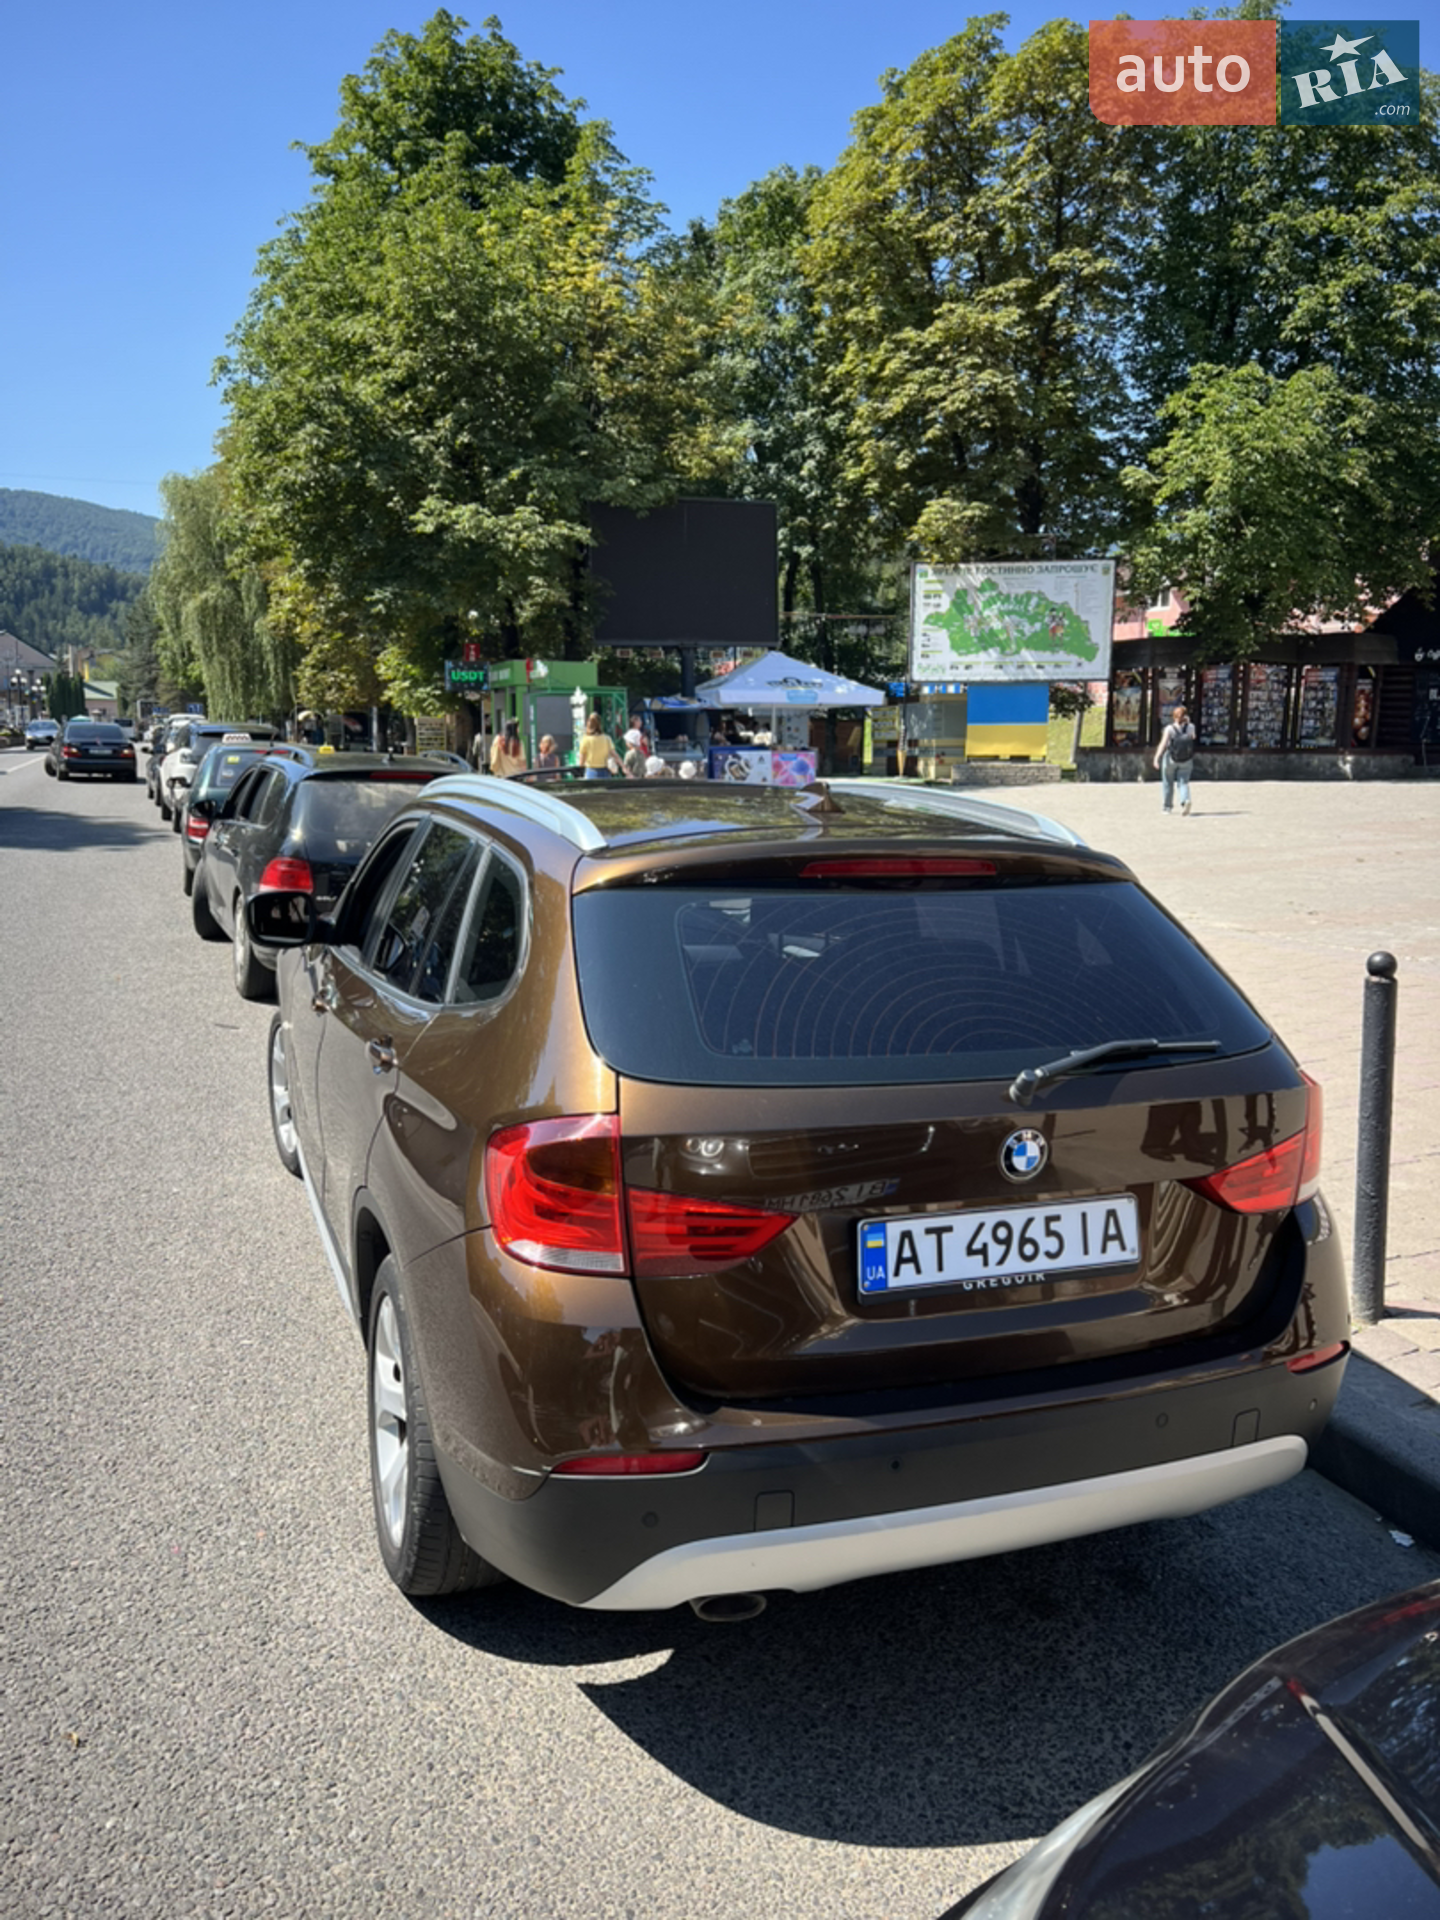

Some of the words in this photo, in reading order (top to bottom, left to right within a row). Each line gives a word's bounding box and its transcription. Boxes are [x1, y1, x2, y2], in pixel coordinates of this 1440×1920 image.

[976, 564, 1035, 576] ГОСТИННО
[1037, 563, 1099, 574] ЗАПРОШУЄ
[451, 671, 485, 682] USDT
[892, 1225, 954, 1278] AT
[965, 1214, 1065, 1268] 4965
[1080, 1208, 1128, 1256] IA
[866, 1265, 886, 1281] UA
